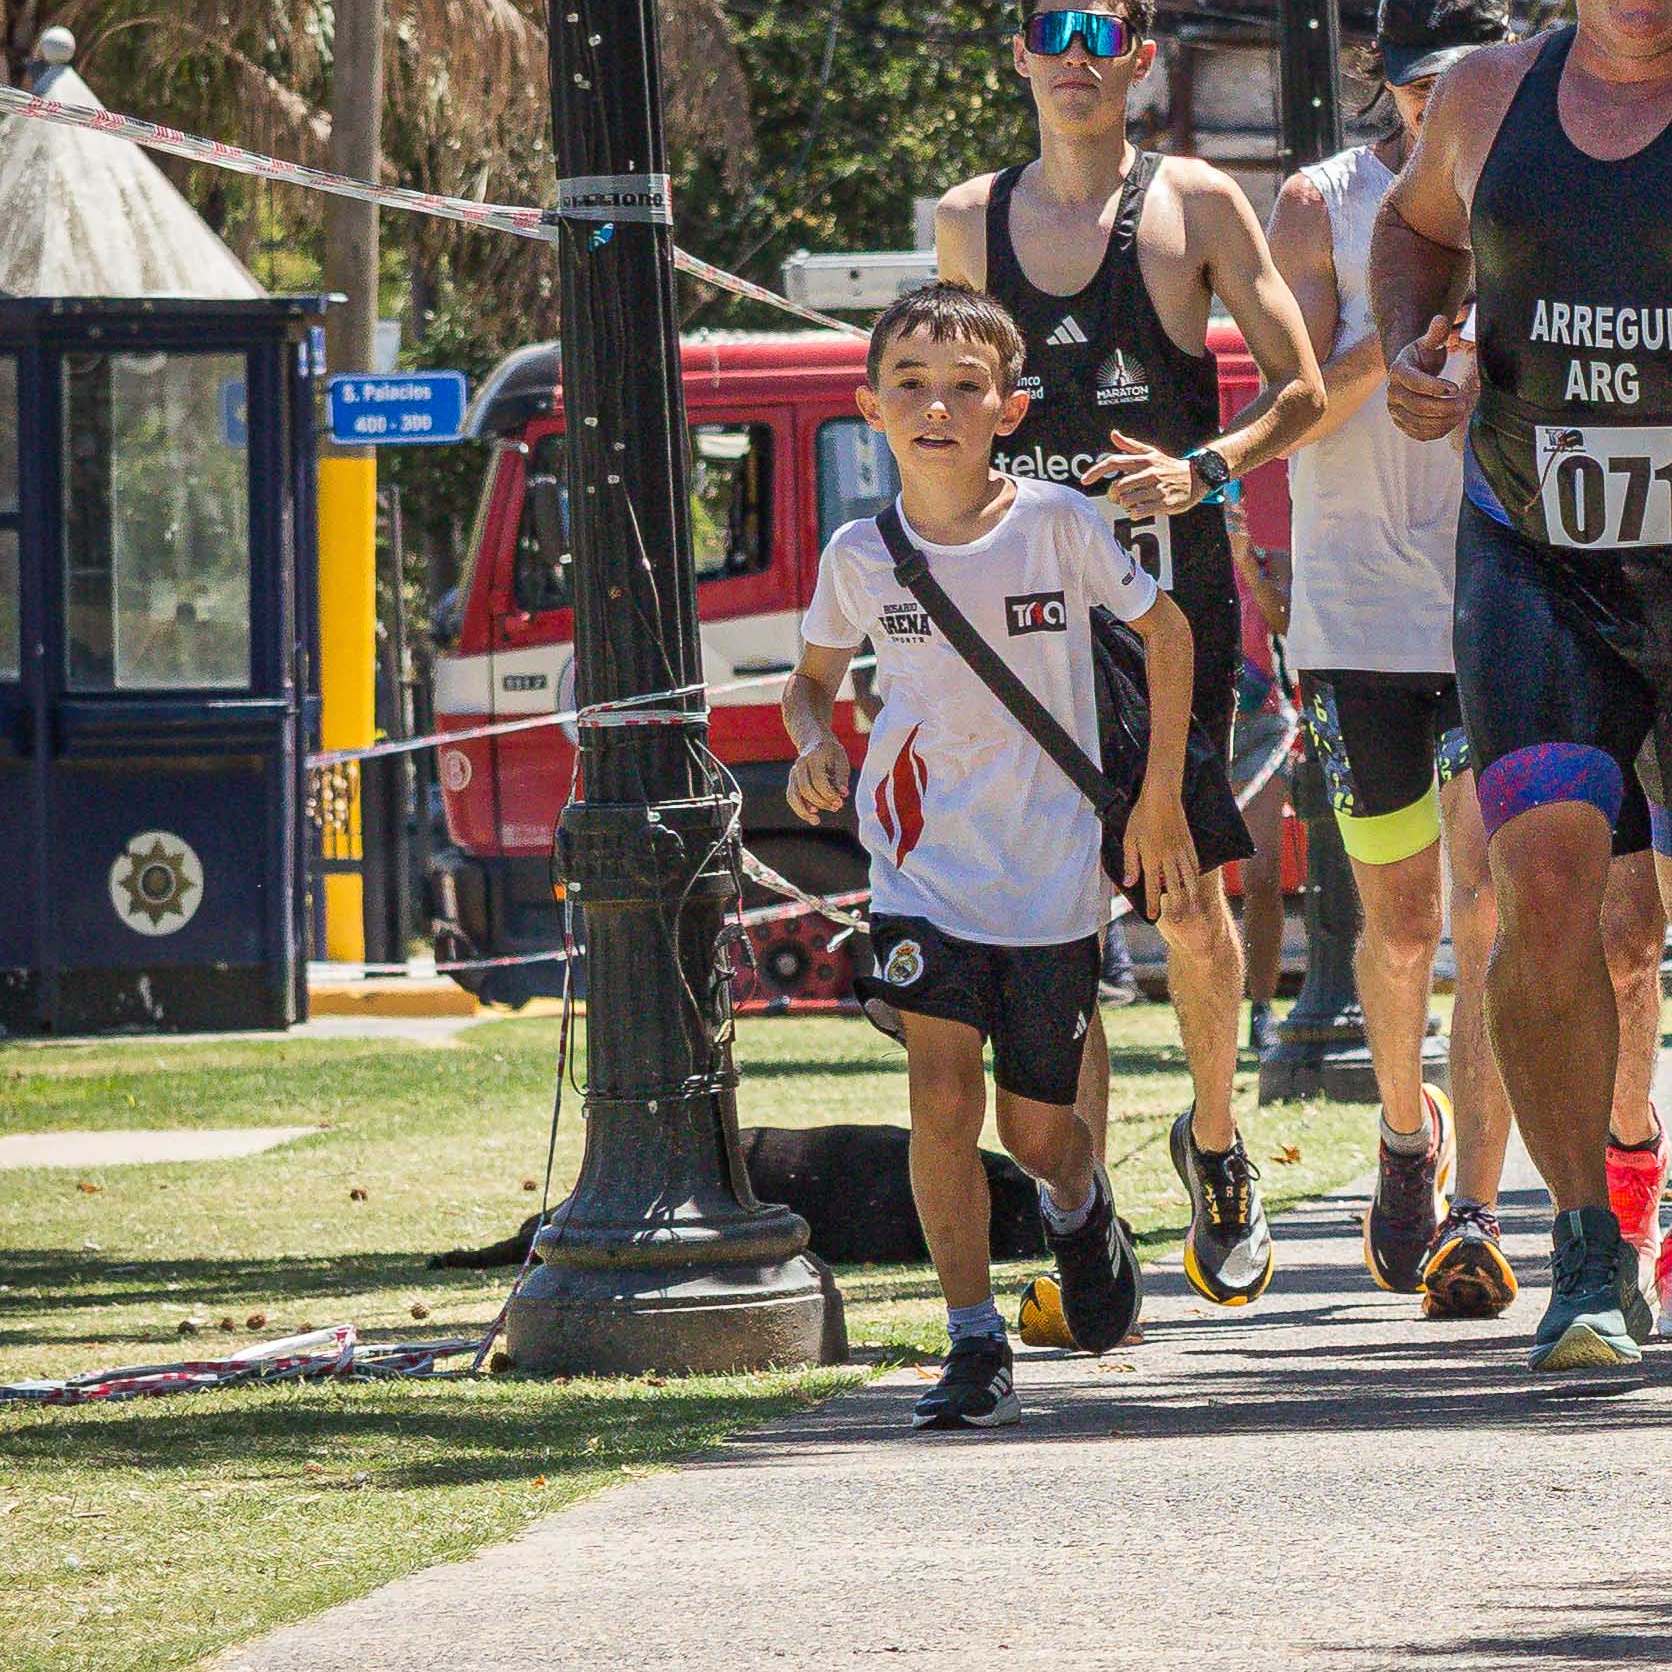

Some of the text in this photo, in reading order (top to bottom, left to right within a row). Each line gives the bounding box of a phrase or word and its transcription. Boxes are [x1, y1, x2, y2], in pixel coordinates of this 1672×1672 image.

[1096, 385, 1149, 400] MARATON
[1564, 359, 1640, 404] ARG
[994, 446, 1122, 481] telec
